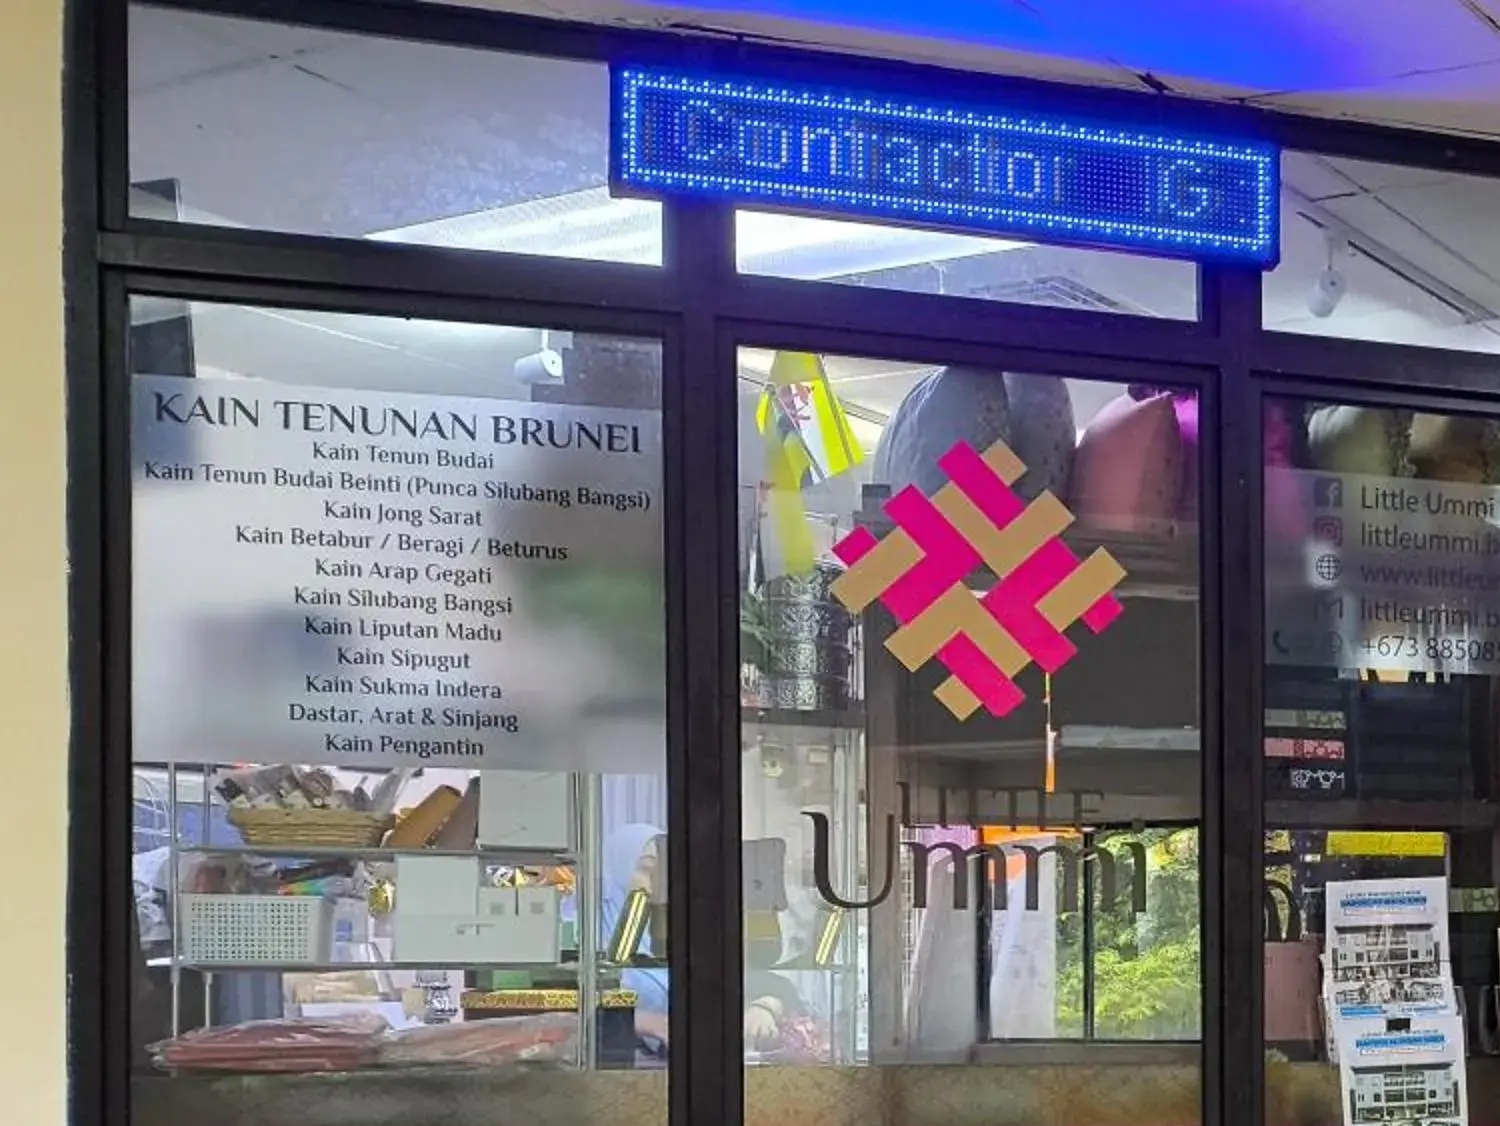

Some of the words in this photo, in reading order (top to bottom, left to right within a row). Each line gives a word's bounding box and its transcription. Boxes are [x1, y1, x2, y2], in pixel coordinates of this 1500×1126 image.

[154, 392, 259, 429] KAIN
[273, 401, 478, 442] TENUNAN
[492, 415, 642, 454] BRUNEI
[312, 441, 359, 462] Kain
[366, 446, 429, 467] Tenun
[436, 448, 494, 470] Budai
[144, 461, 194, 482] Kain
[201, 464, 267, 486] Tenun
[273, 467, 333, 490] Budai
[340, 471, 400, 494] Beinti
[407, 475, 478, 499] (Punca
[483, 480, 571, 508] Silubang
[577, 487, 651, 511] Bangsi)
[324, 500, 371, 521] Kain
[376, 503, 424, 528] Jong
[429, 506, 483, 527] Sarat
[1361, 486, 1420, 512] Little
[1426, 489, 1495, 518] Ummi
[235, 524, 283, 545] Kain
[289, 527, 374, 549] Betabur
[398, 532, 464, 557] Beragi
[487, 538, 568, 561] Beturus
[314, 558, 363, 579] Kain
[368, 561, 419, 585] Arap
[425, 563, 492, 588] Gegati
[293, 586, 342, 607] Kain
[347, 588, 437, 615] Silubang
[444, 593, 513, 618] Bangsi
[304, 616, 353, 637] Kain
[358, 618, 438, 642] Liputan
[445, 622, 503, 643] Madu
[337, 646, 385, 667] Kain
[390, 647, 471, 672] Sipugut
[1362, 635, 1419, 658] +673
[305, 674, 354, 696] Kain
[358, 676, 430, 698] Sukma
[435, 678, 502, 701] Indera
[288, 703, 364, 727] Dastar,
[370, 705, 416, 727] Arat
[441, 707, 519, 734] Sinjang
[325, 734, 373, 754] Kain
[379, 736, 485, 759] Pengantin
[896, 781, 1105, 833] LITTLE
[801, 810, 1147, 912] Ummi
